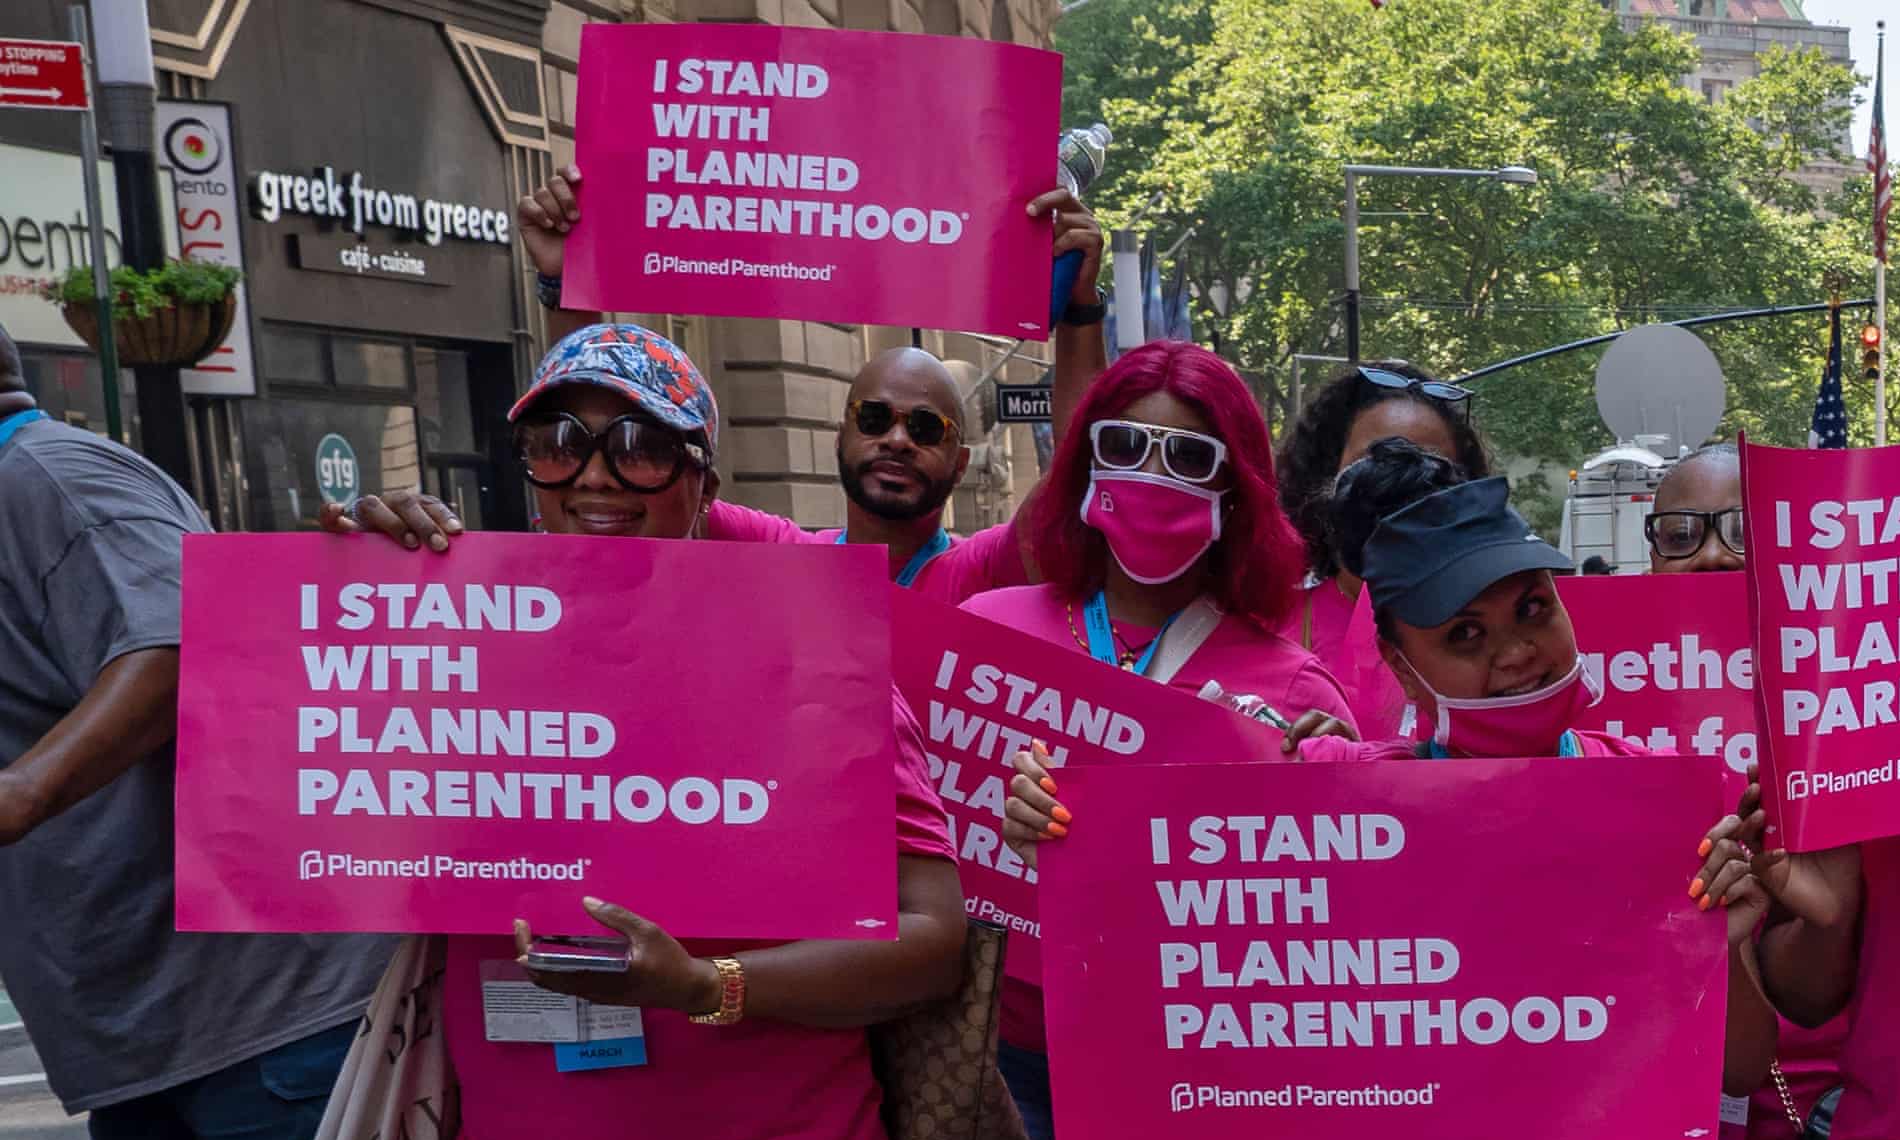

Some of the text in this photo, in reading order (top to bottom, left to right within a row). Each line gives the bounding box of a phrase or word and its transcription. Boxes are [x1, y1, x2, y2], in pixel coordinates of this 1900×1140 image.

[654, 59, 829, 98] I STAND
[653, 104, 769, 141] WITH
[176, 177, 227, 197] ento
[647, 148, 859, 192] PLANNED
[259, 168, 510, 244] greek from greece
[646, 194, 962, 244] PARENTHOOD
[379, 252, 425, 276] cuisine
[663, 256, 831, 280] Planned Parenthood
[320, 449, 355, 489] gfg
[1776, 500, 1792, 547] I
[300, 583, 562, 632] I STAND
[300, 646, 479, 692] WITH
[935, 650, 1145, 755] I STAND
[298, 707, 615, 758] PLANNED
[298, 769, 770, 824] PARENTHOOD
[1812, 761, 1893, 794] Planned
[1151, 814, 1405, 864] I STAND
[329, 855, 583, 880] Planned Parenthood
[1156, 878, 1329, 926] WITH
[1160, 939, 1459, 987] PLANNED
[1164, 996, 1608, 1049] PARENTHOOD
[1199, 1083, 1432, 1107] Planned Parenthood
